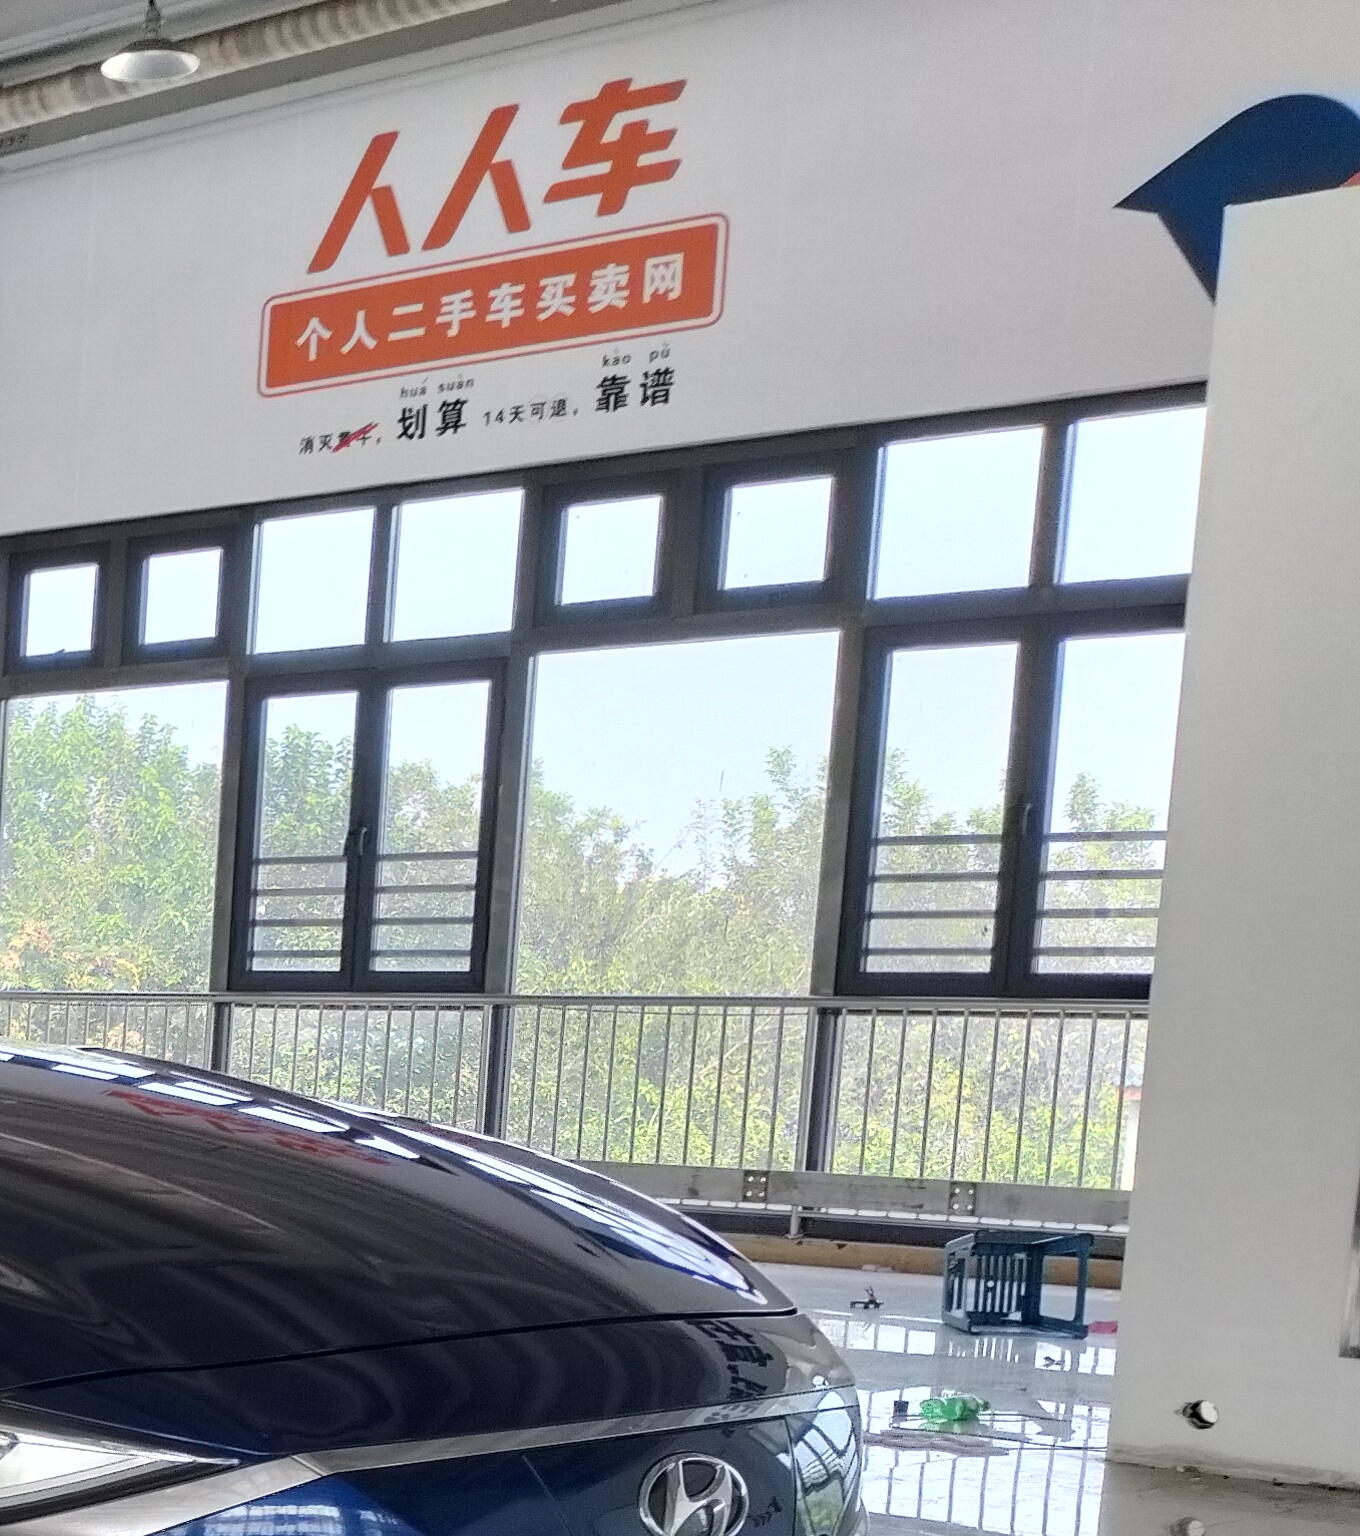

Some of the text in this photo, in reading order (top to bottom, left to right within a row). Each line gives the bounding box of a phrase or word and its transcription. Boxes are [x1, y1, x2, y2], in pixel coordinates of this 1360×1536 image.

[307, 78, 688, 274] 人人车
[294, 252, 685, 362] 个人二手车买卖网
